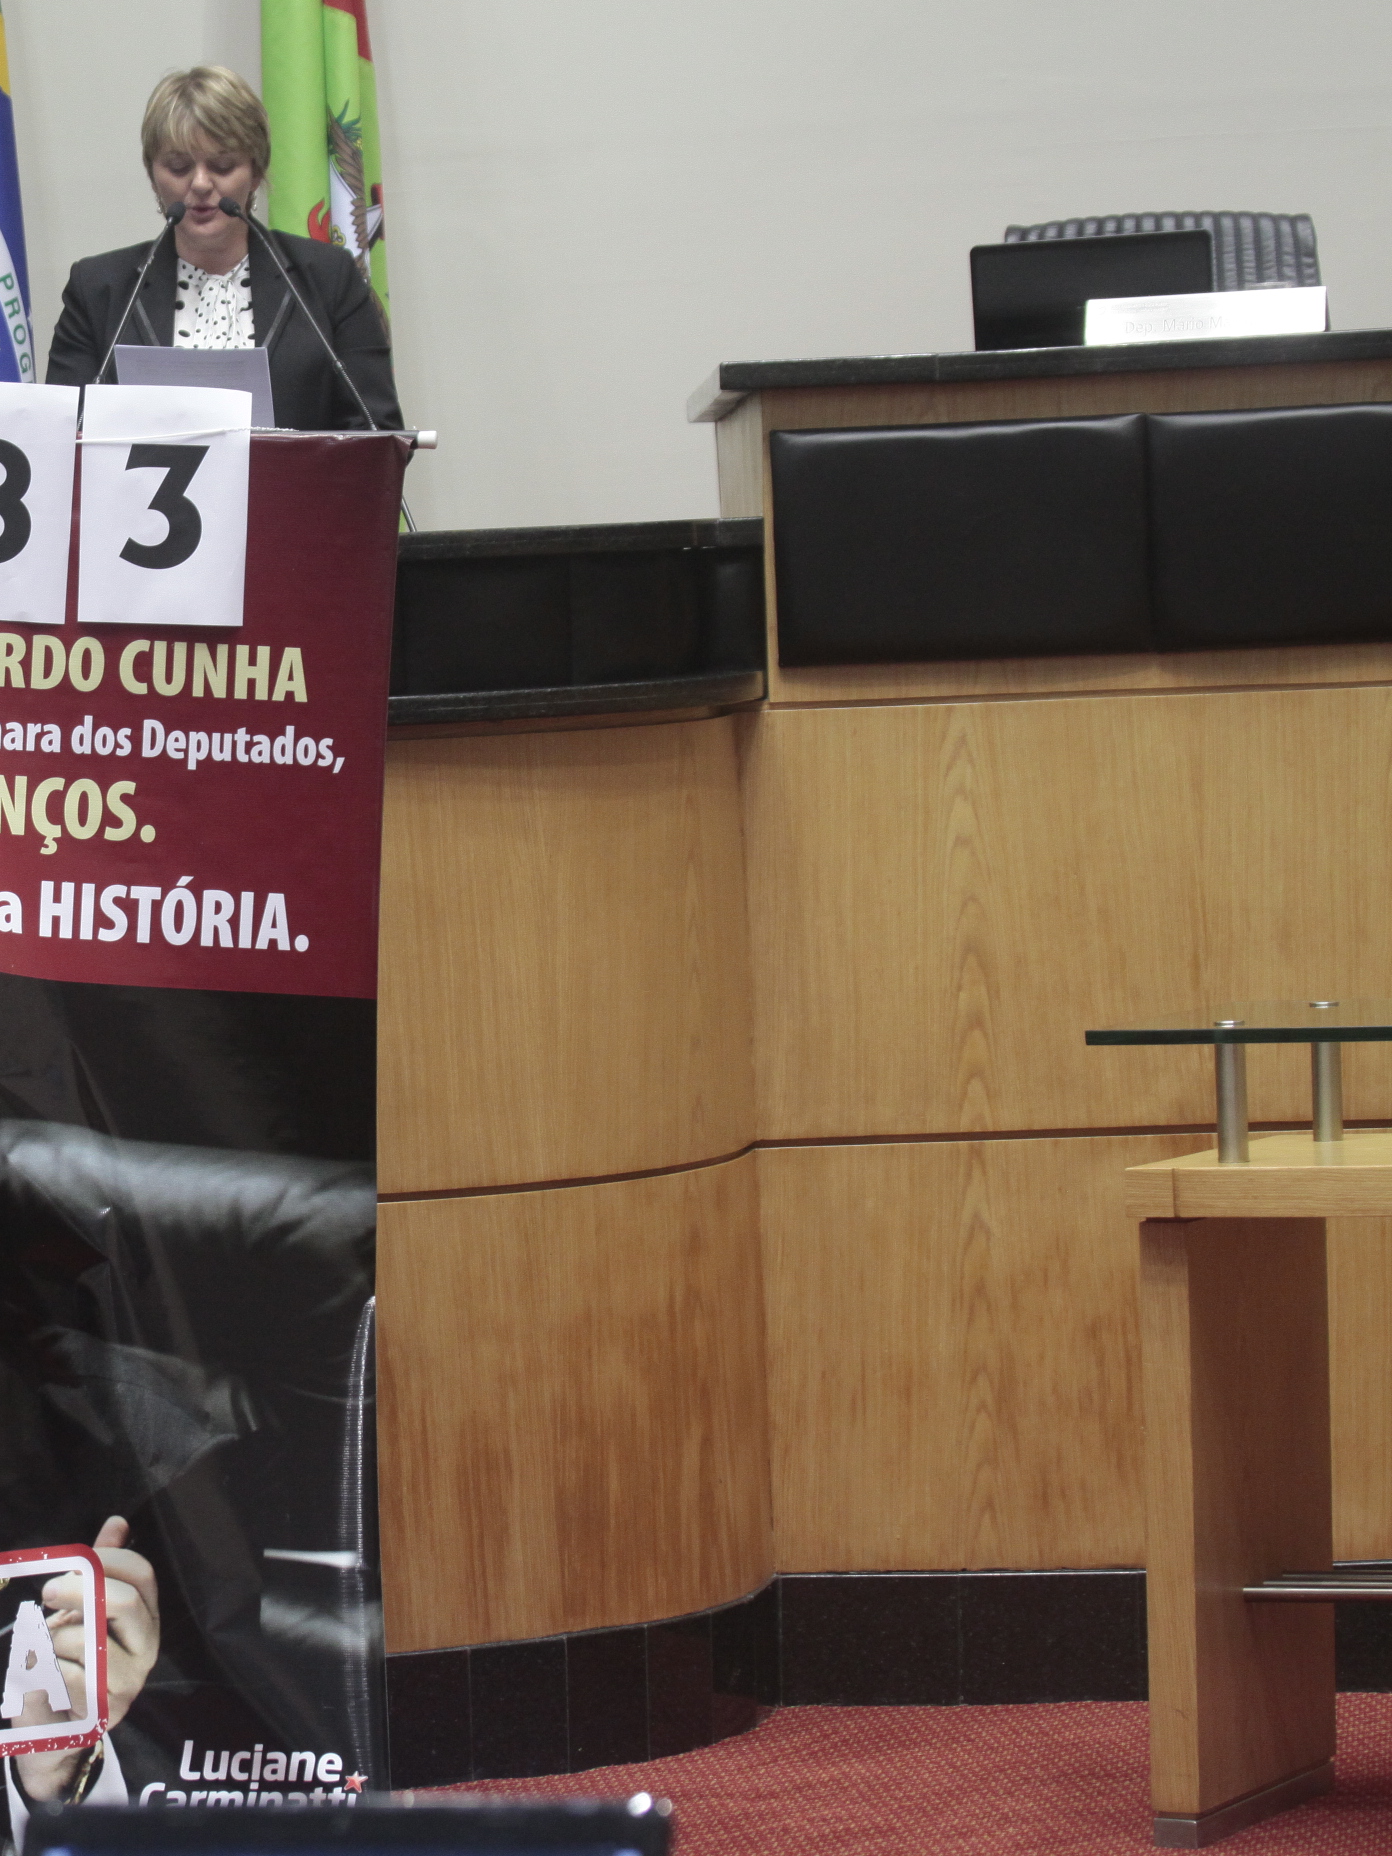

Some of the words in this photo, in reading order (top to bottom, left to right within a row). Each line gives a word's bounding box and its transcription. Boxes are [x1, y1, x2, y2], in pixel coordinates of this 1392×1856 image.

[119, 639, 308, 703] CUNHA
[70, 715, 132, 757] dos
[141, 719, 346, 774] Deputados,
[38, 875, 310, 953] HISTÓRIA.
[179, 1739, 343, 1783] Luciane
